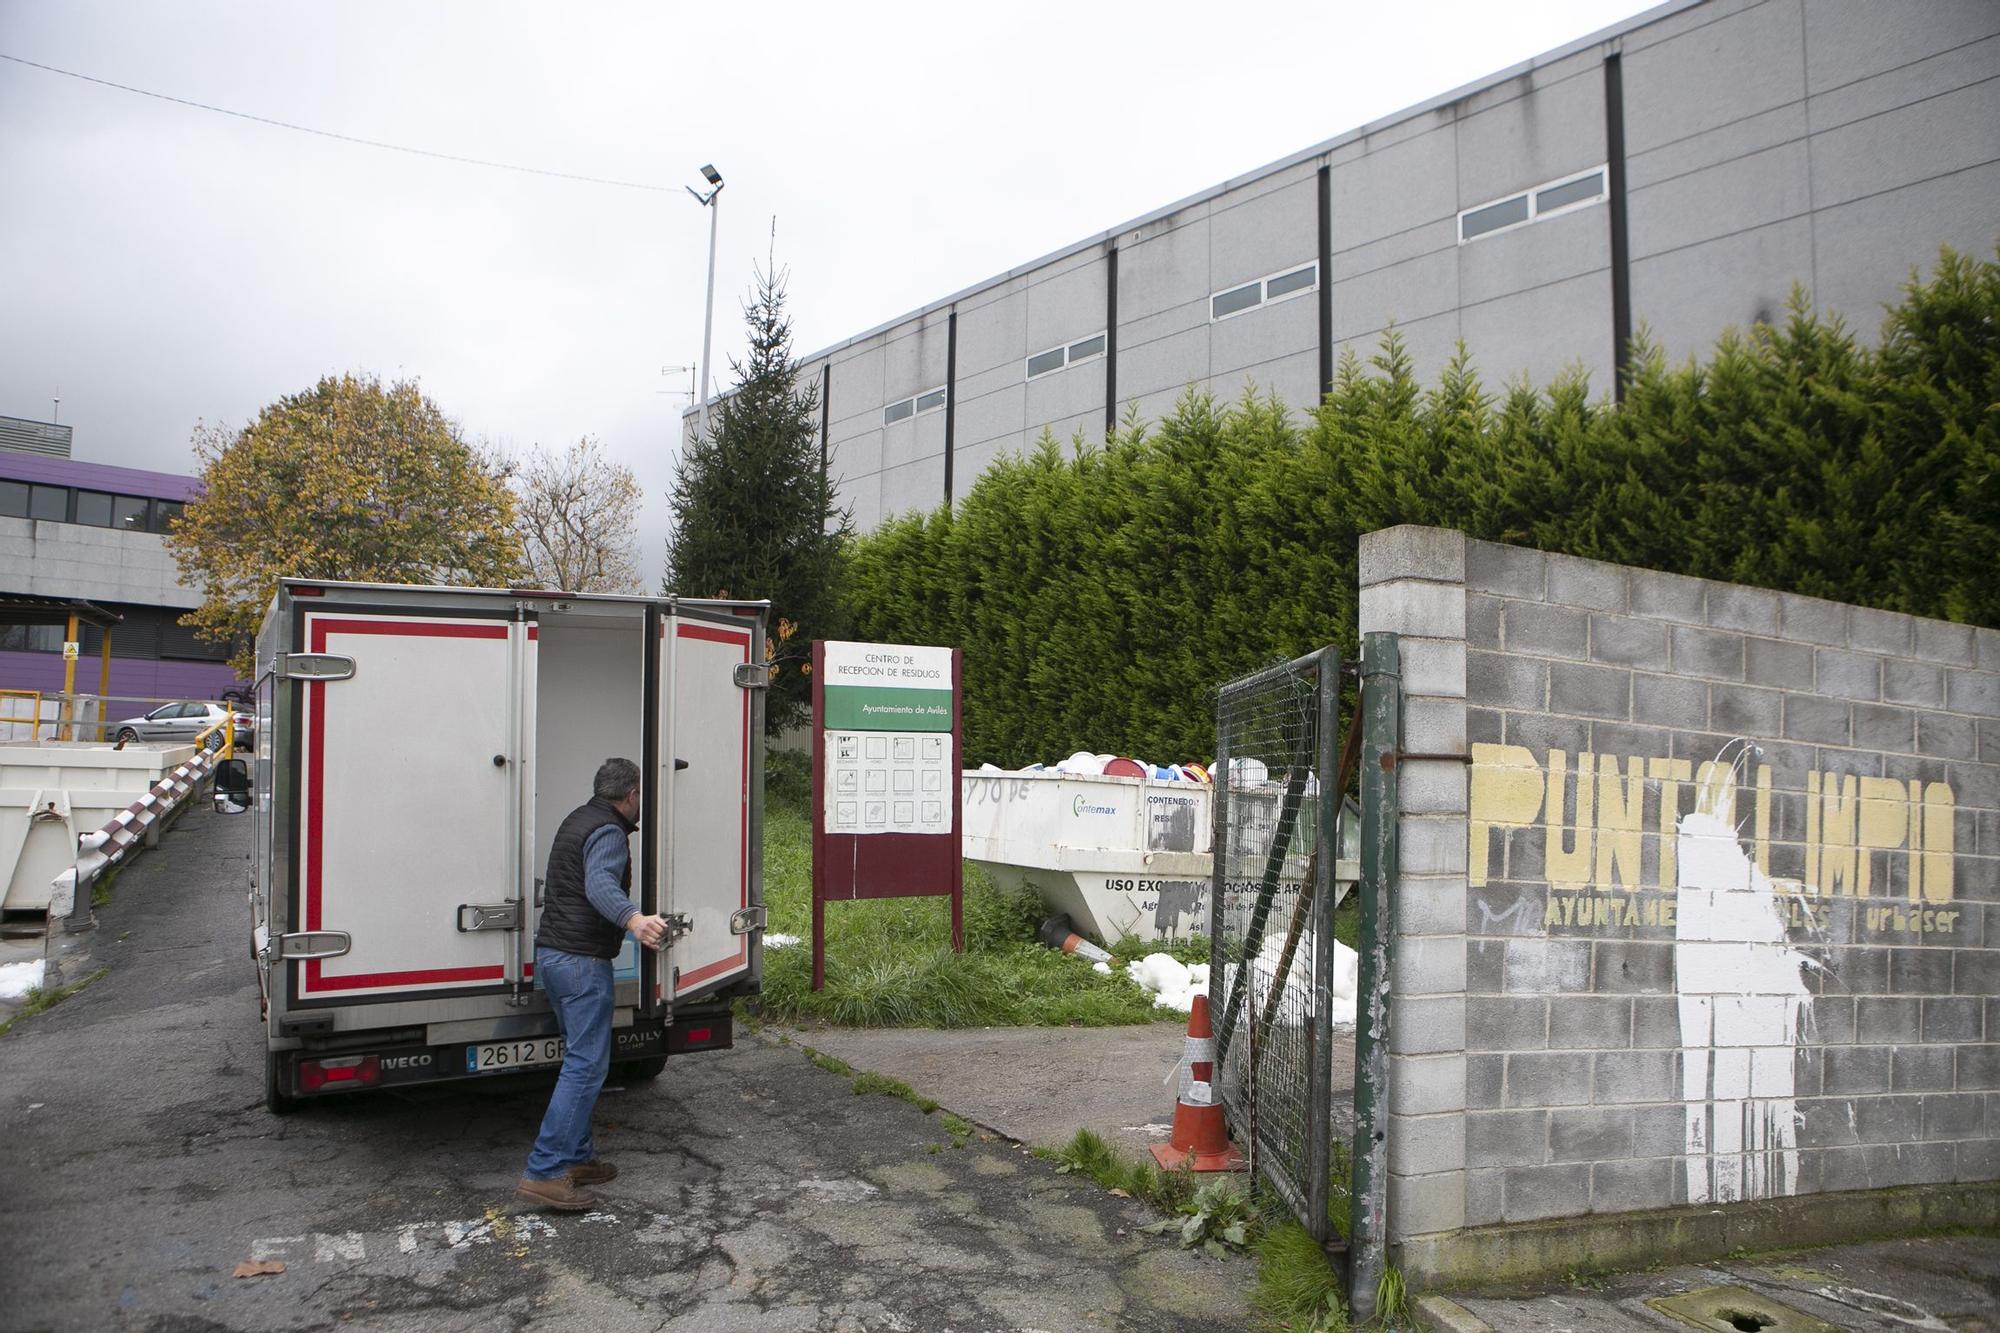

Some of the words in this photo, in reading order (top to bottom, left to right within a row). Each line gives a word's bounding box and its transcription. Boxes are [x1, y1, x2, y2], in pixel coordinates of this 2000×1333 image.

[865, 654, 900, 664] CENTRO
[904, 656, 915, 665] DE
[838, 665, 884, 676] RECEPCION
[887, 668, 898, 677] DE
[902, 668, 941, 679] RESIDUOS
[862, 704, 914, 715] Ayuntamiento
[915, 704, 925, 714] de
[1147, 796, 1200, 806] CONTENEDO
[1105, 879, 1134, 892] USO
[1866, 905, 1960, 934] urbaser
[617, 1031, 663, 1044] DAILY
[482, 1043, 536, 1067] 2612
[380, 1054, 433, 1071] IVECO
